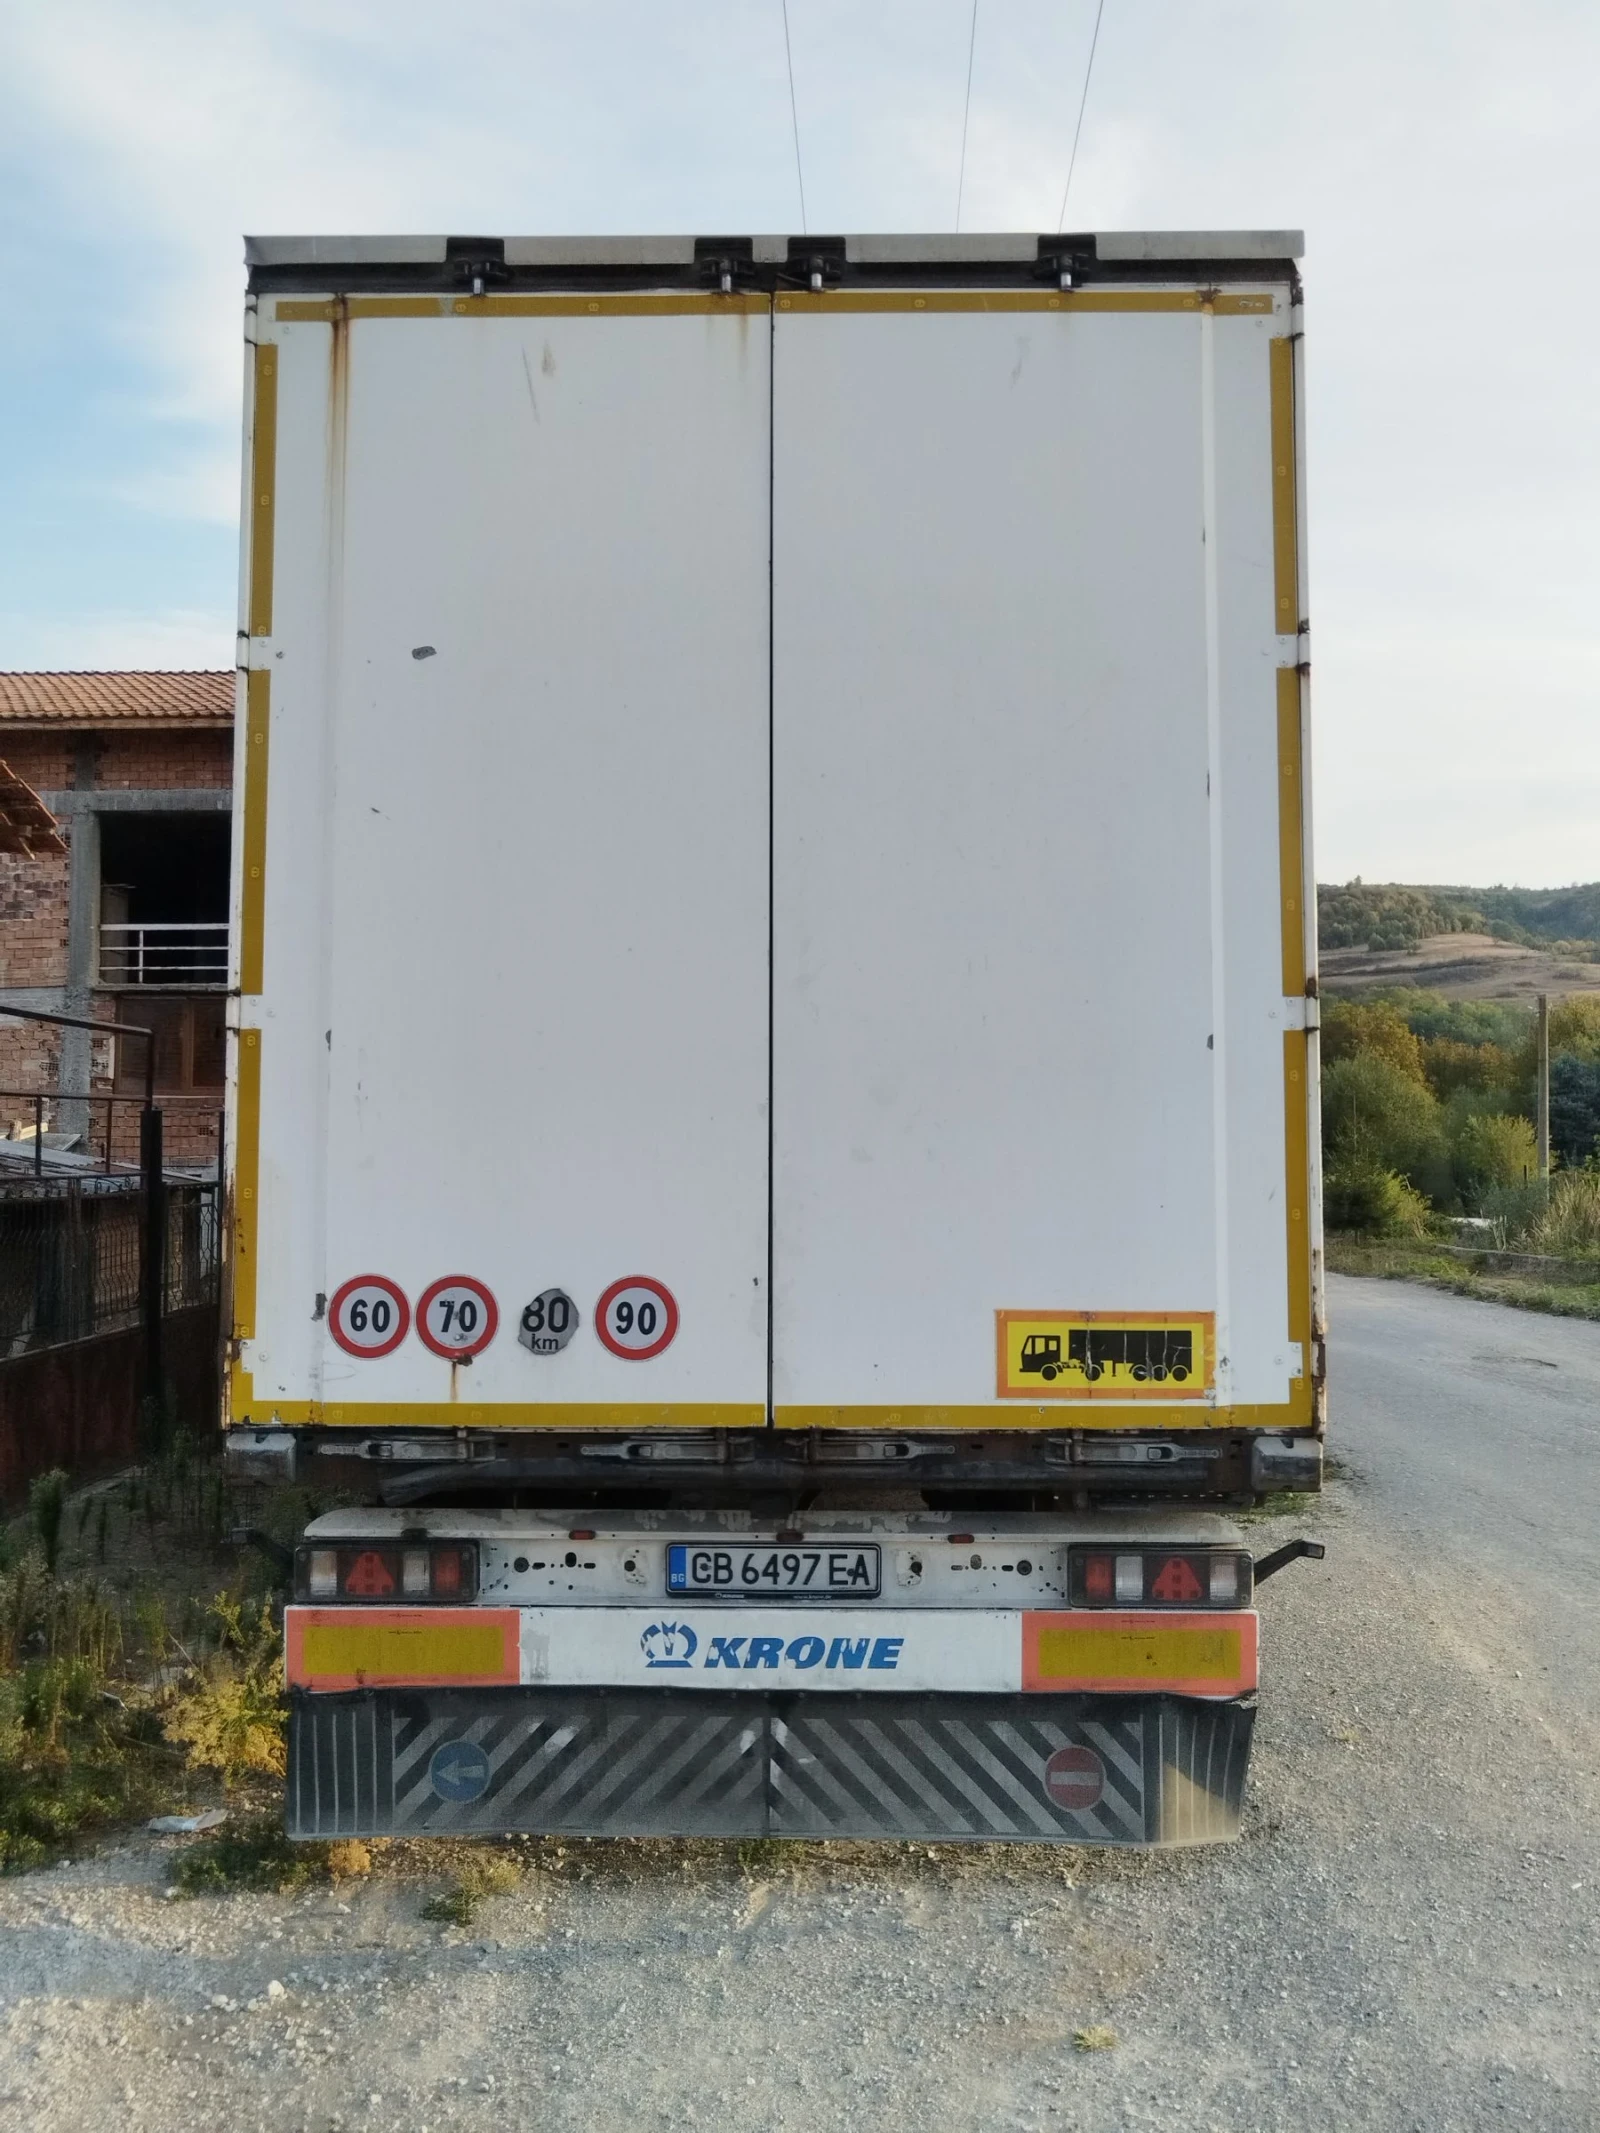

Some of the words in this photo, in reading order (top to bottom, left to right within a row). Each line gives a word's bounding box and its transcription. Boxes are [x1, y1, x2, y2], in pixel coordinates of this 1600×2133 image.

[350, 1299, 391, 1333] 60
[439, 1300, 478, 1333] 70
[522, 1296, 570, 1333] 80
[615, 1301, 657, 1335] 90
[531, 1334, 559, 1351] km
[670, 1573, 685, 1583] BG
[741, 1553, 821, 1586] 6497
[704, 1636, 904, 1670] KRONE
